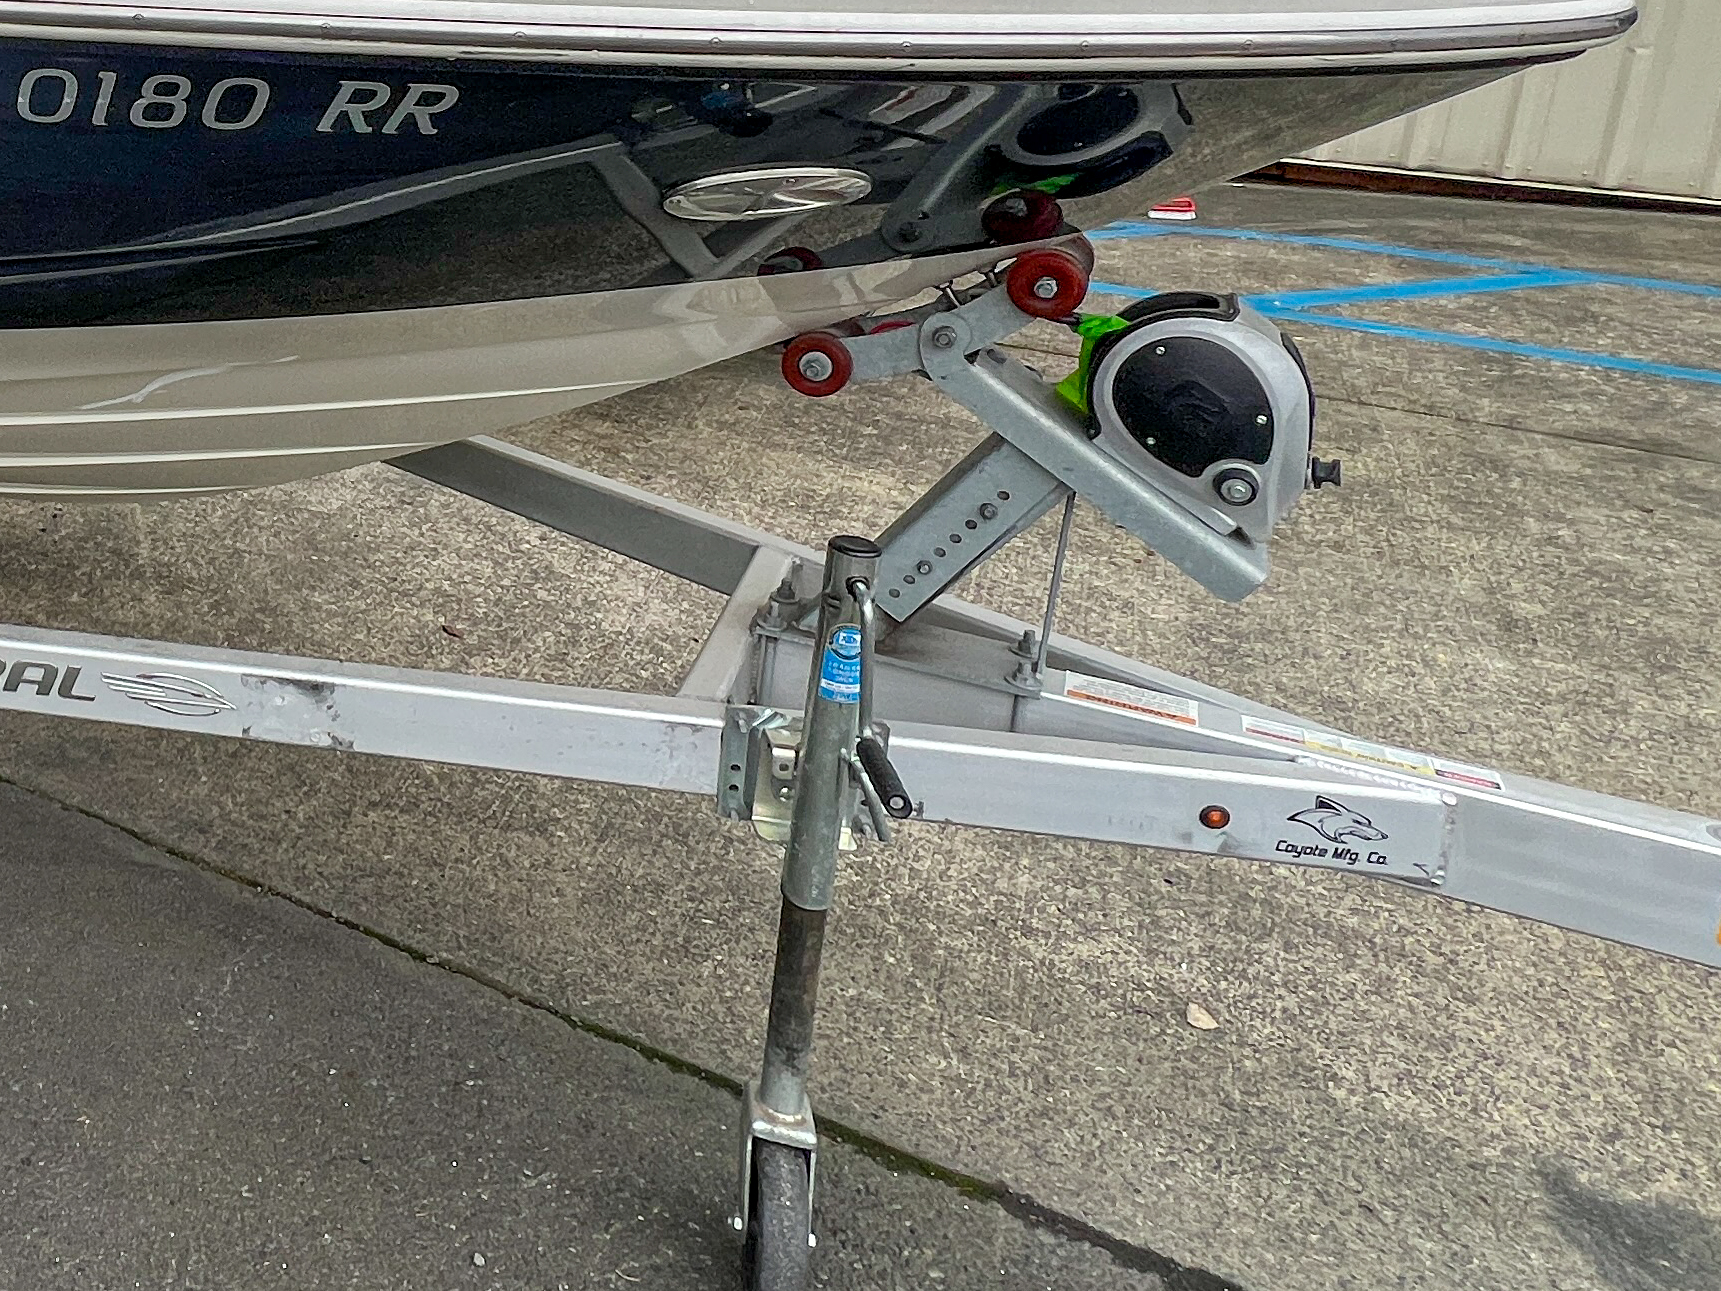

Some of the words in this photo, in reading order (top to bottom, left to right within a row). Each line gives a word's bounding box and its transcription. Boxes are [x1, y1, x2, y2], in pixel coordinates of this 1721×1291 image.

[16, 68, 271, 131] 0180
[315, 80, 461, 135] RR
[1275, 840, 1329, 859] Coyote
